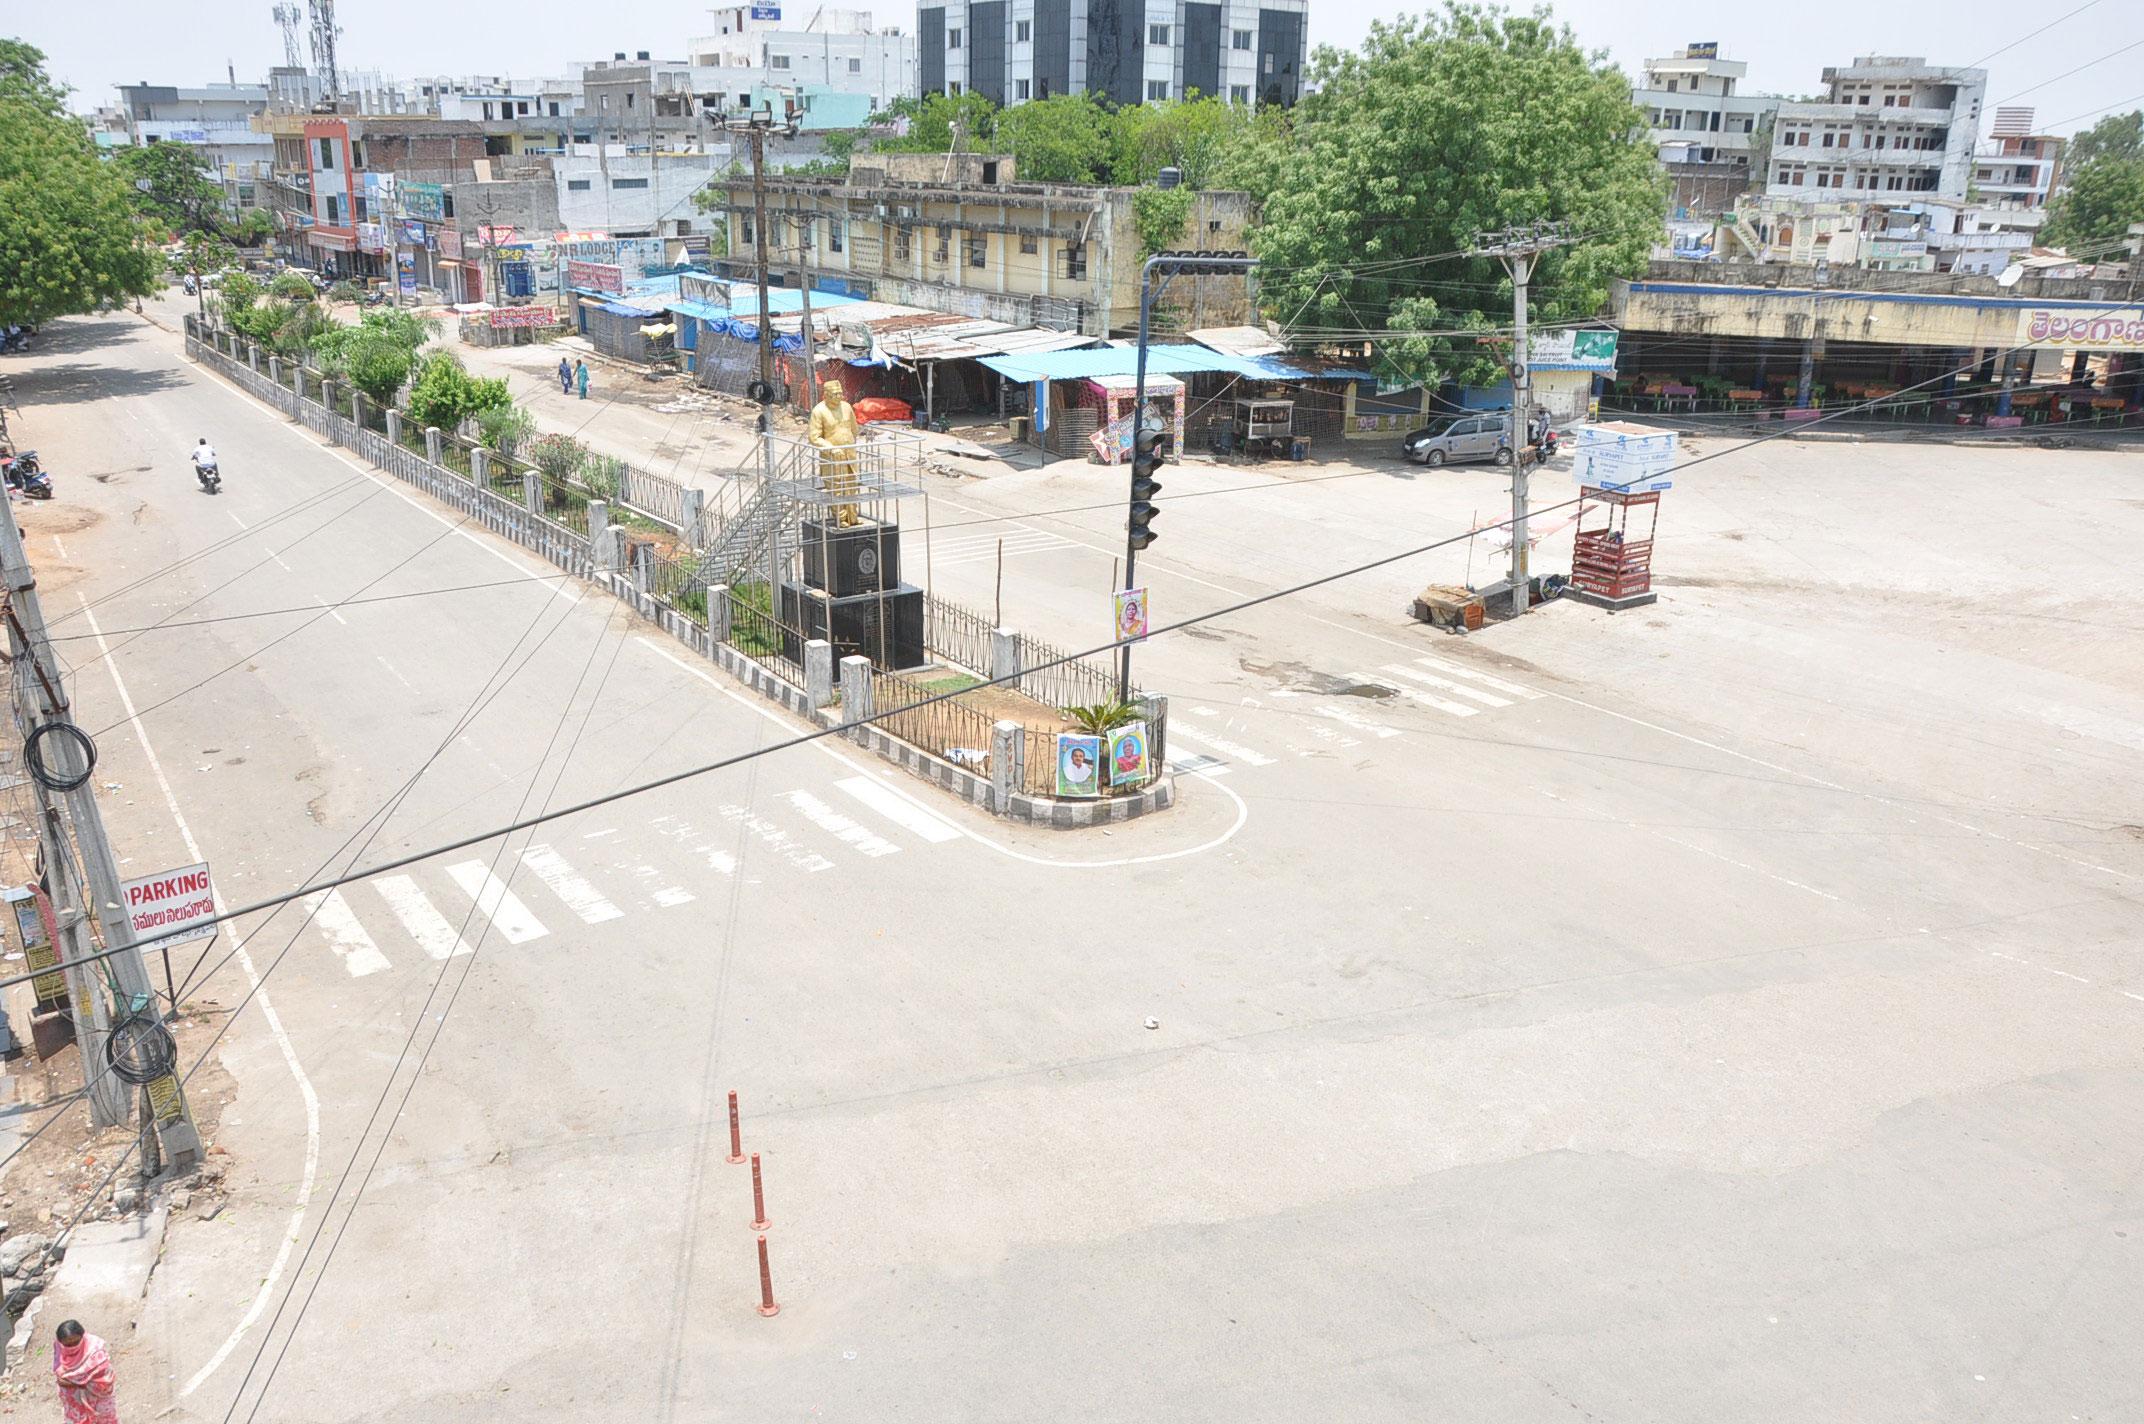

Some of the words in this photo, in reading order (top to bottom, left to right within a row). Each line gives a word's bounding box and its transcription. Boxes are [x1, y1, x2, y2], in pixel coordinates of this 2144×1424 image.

[580, 240, 616, 256] LODGE
[1621, 583, 1646, 594] SURYAPET
[130, 871, 209, 906] PARKING
